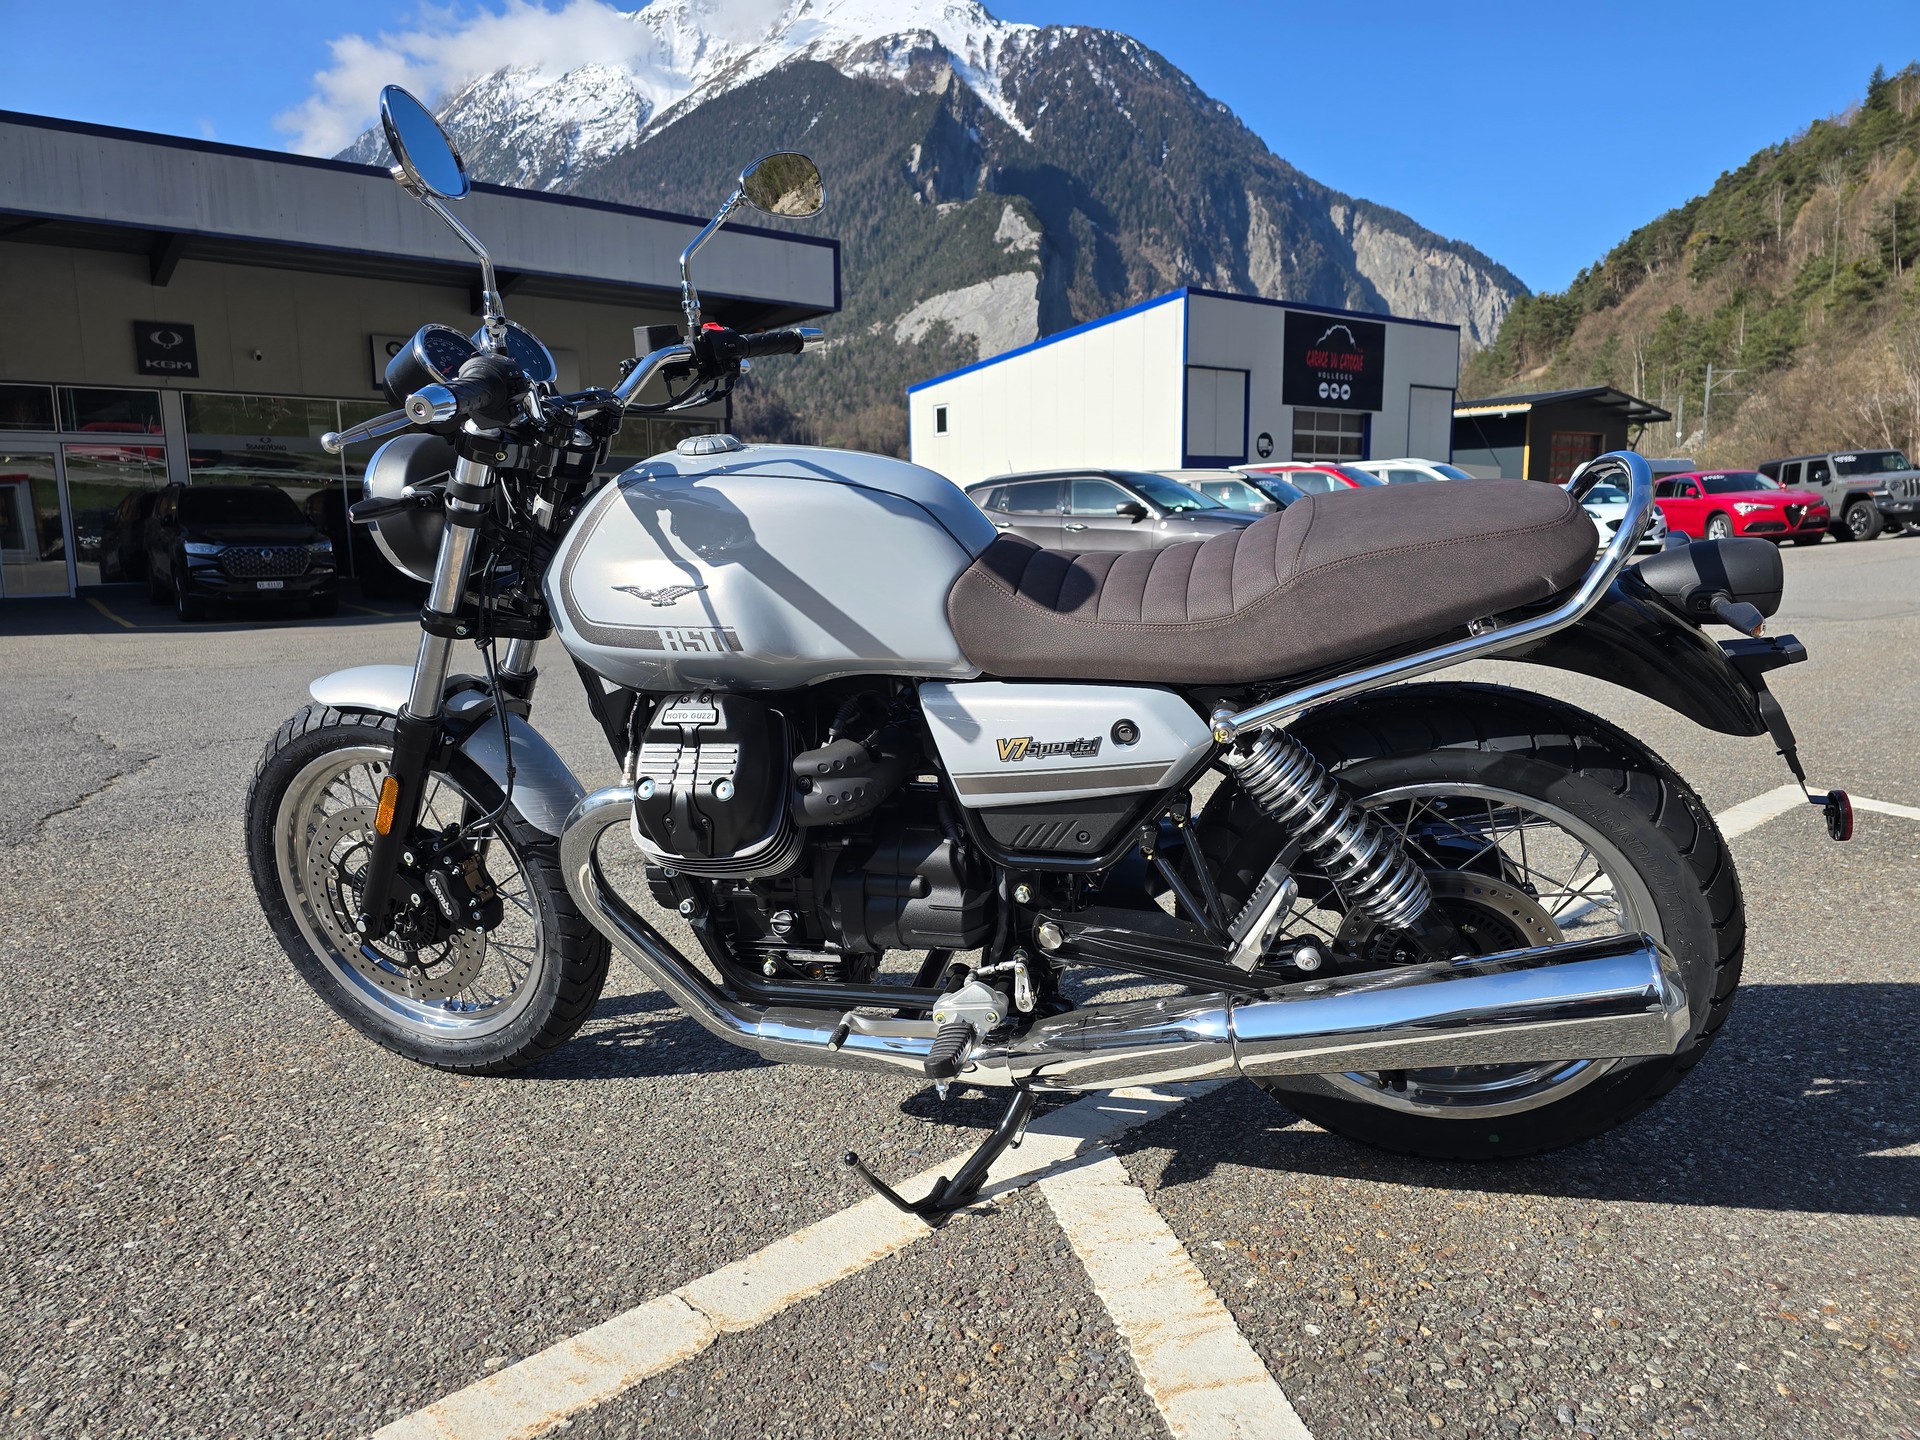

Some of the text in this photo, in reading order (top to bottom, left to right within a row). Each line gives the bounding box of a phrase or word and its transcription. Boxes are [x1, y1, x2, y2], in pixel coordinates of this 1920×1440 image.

[145, 359, 192, 370] KGM
[657, 627, 735, 652] 850
[997, 736, 1101, 761] V7 Special
[429, 878, 453, 916] brembo
